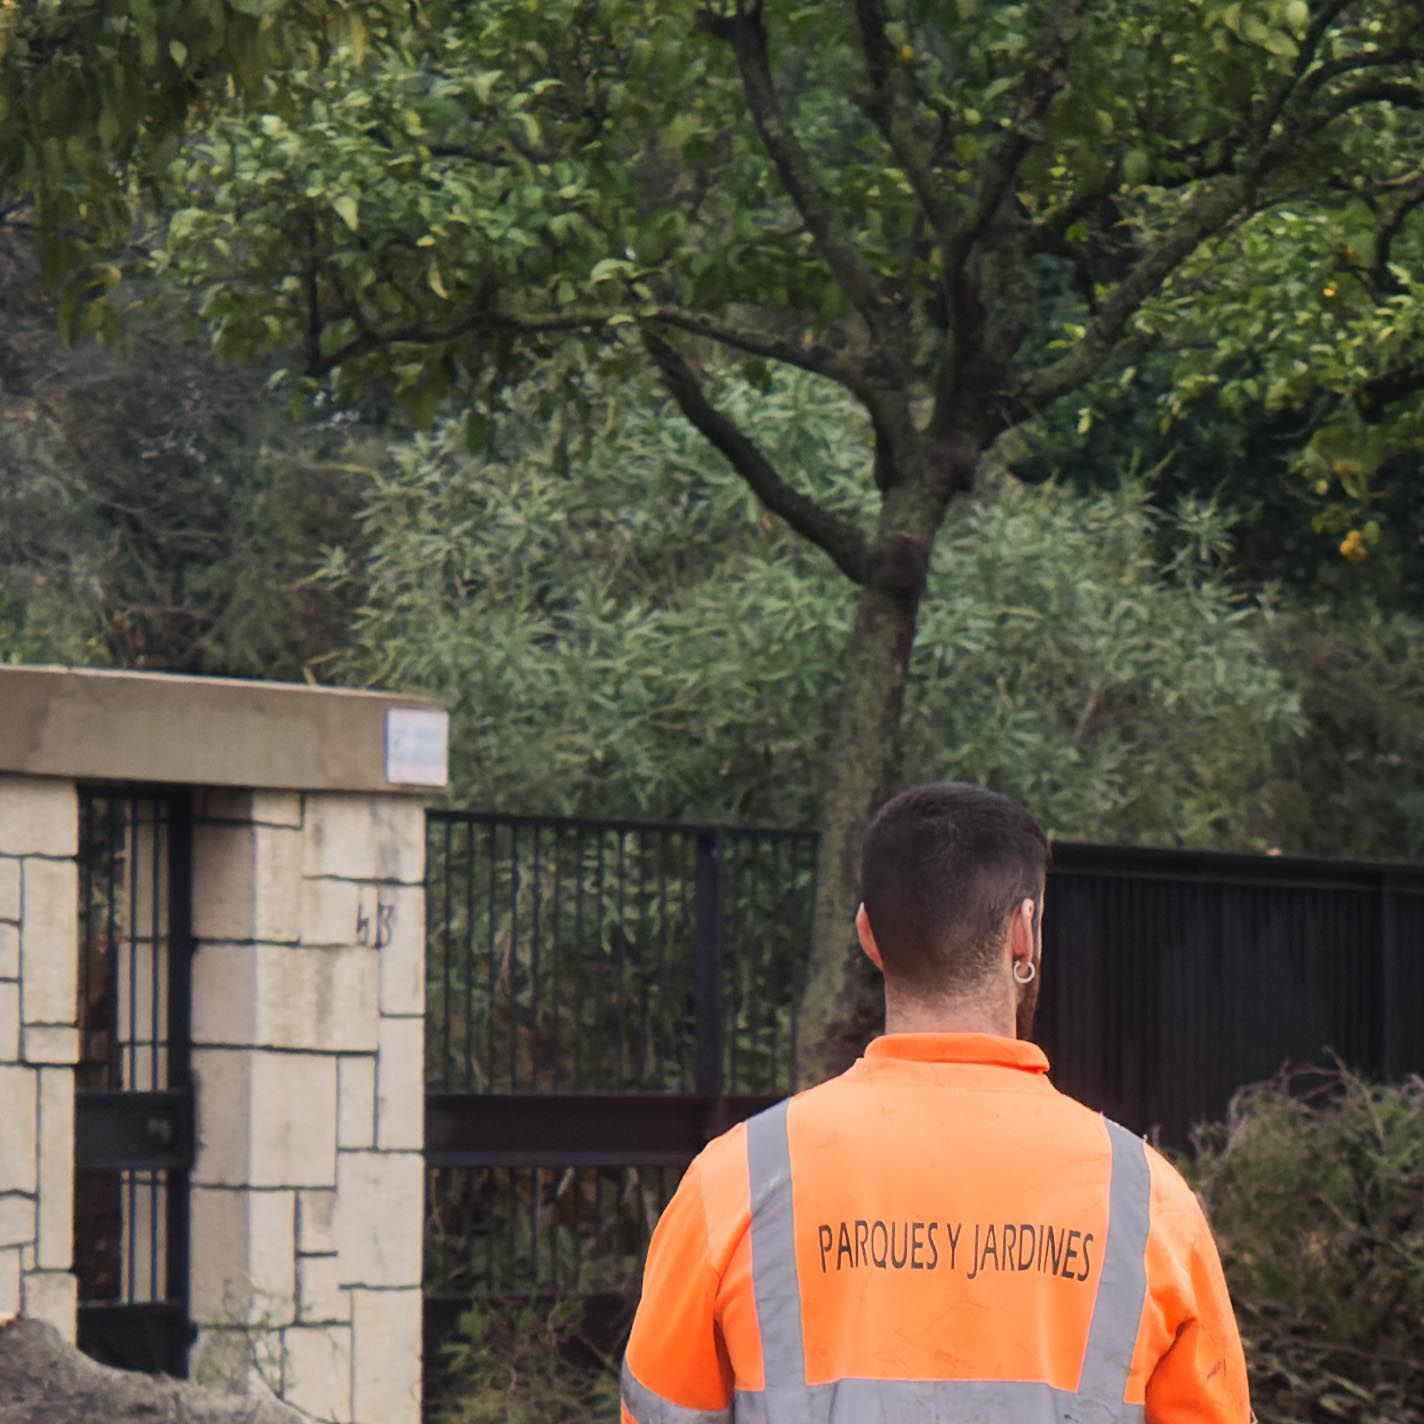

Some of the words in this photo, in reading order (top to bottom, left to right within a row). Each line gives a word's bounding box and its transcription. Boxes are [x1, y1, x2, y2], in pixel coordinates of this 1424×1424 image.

[818, 1219, 938, 1273] PARQUES
[946, 1222, 962, 1271] Y
[966, 1222, 1094, 1282] JARDINES
